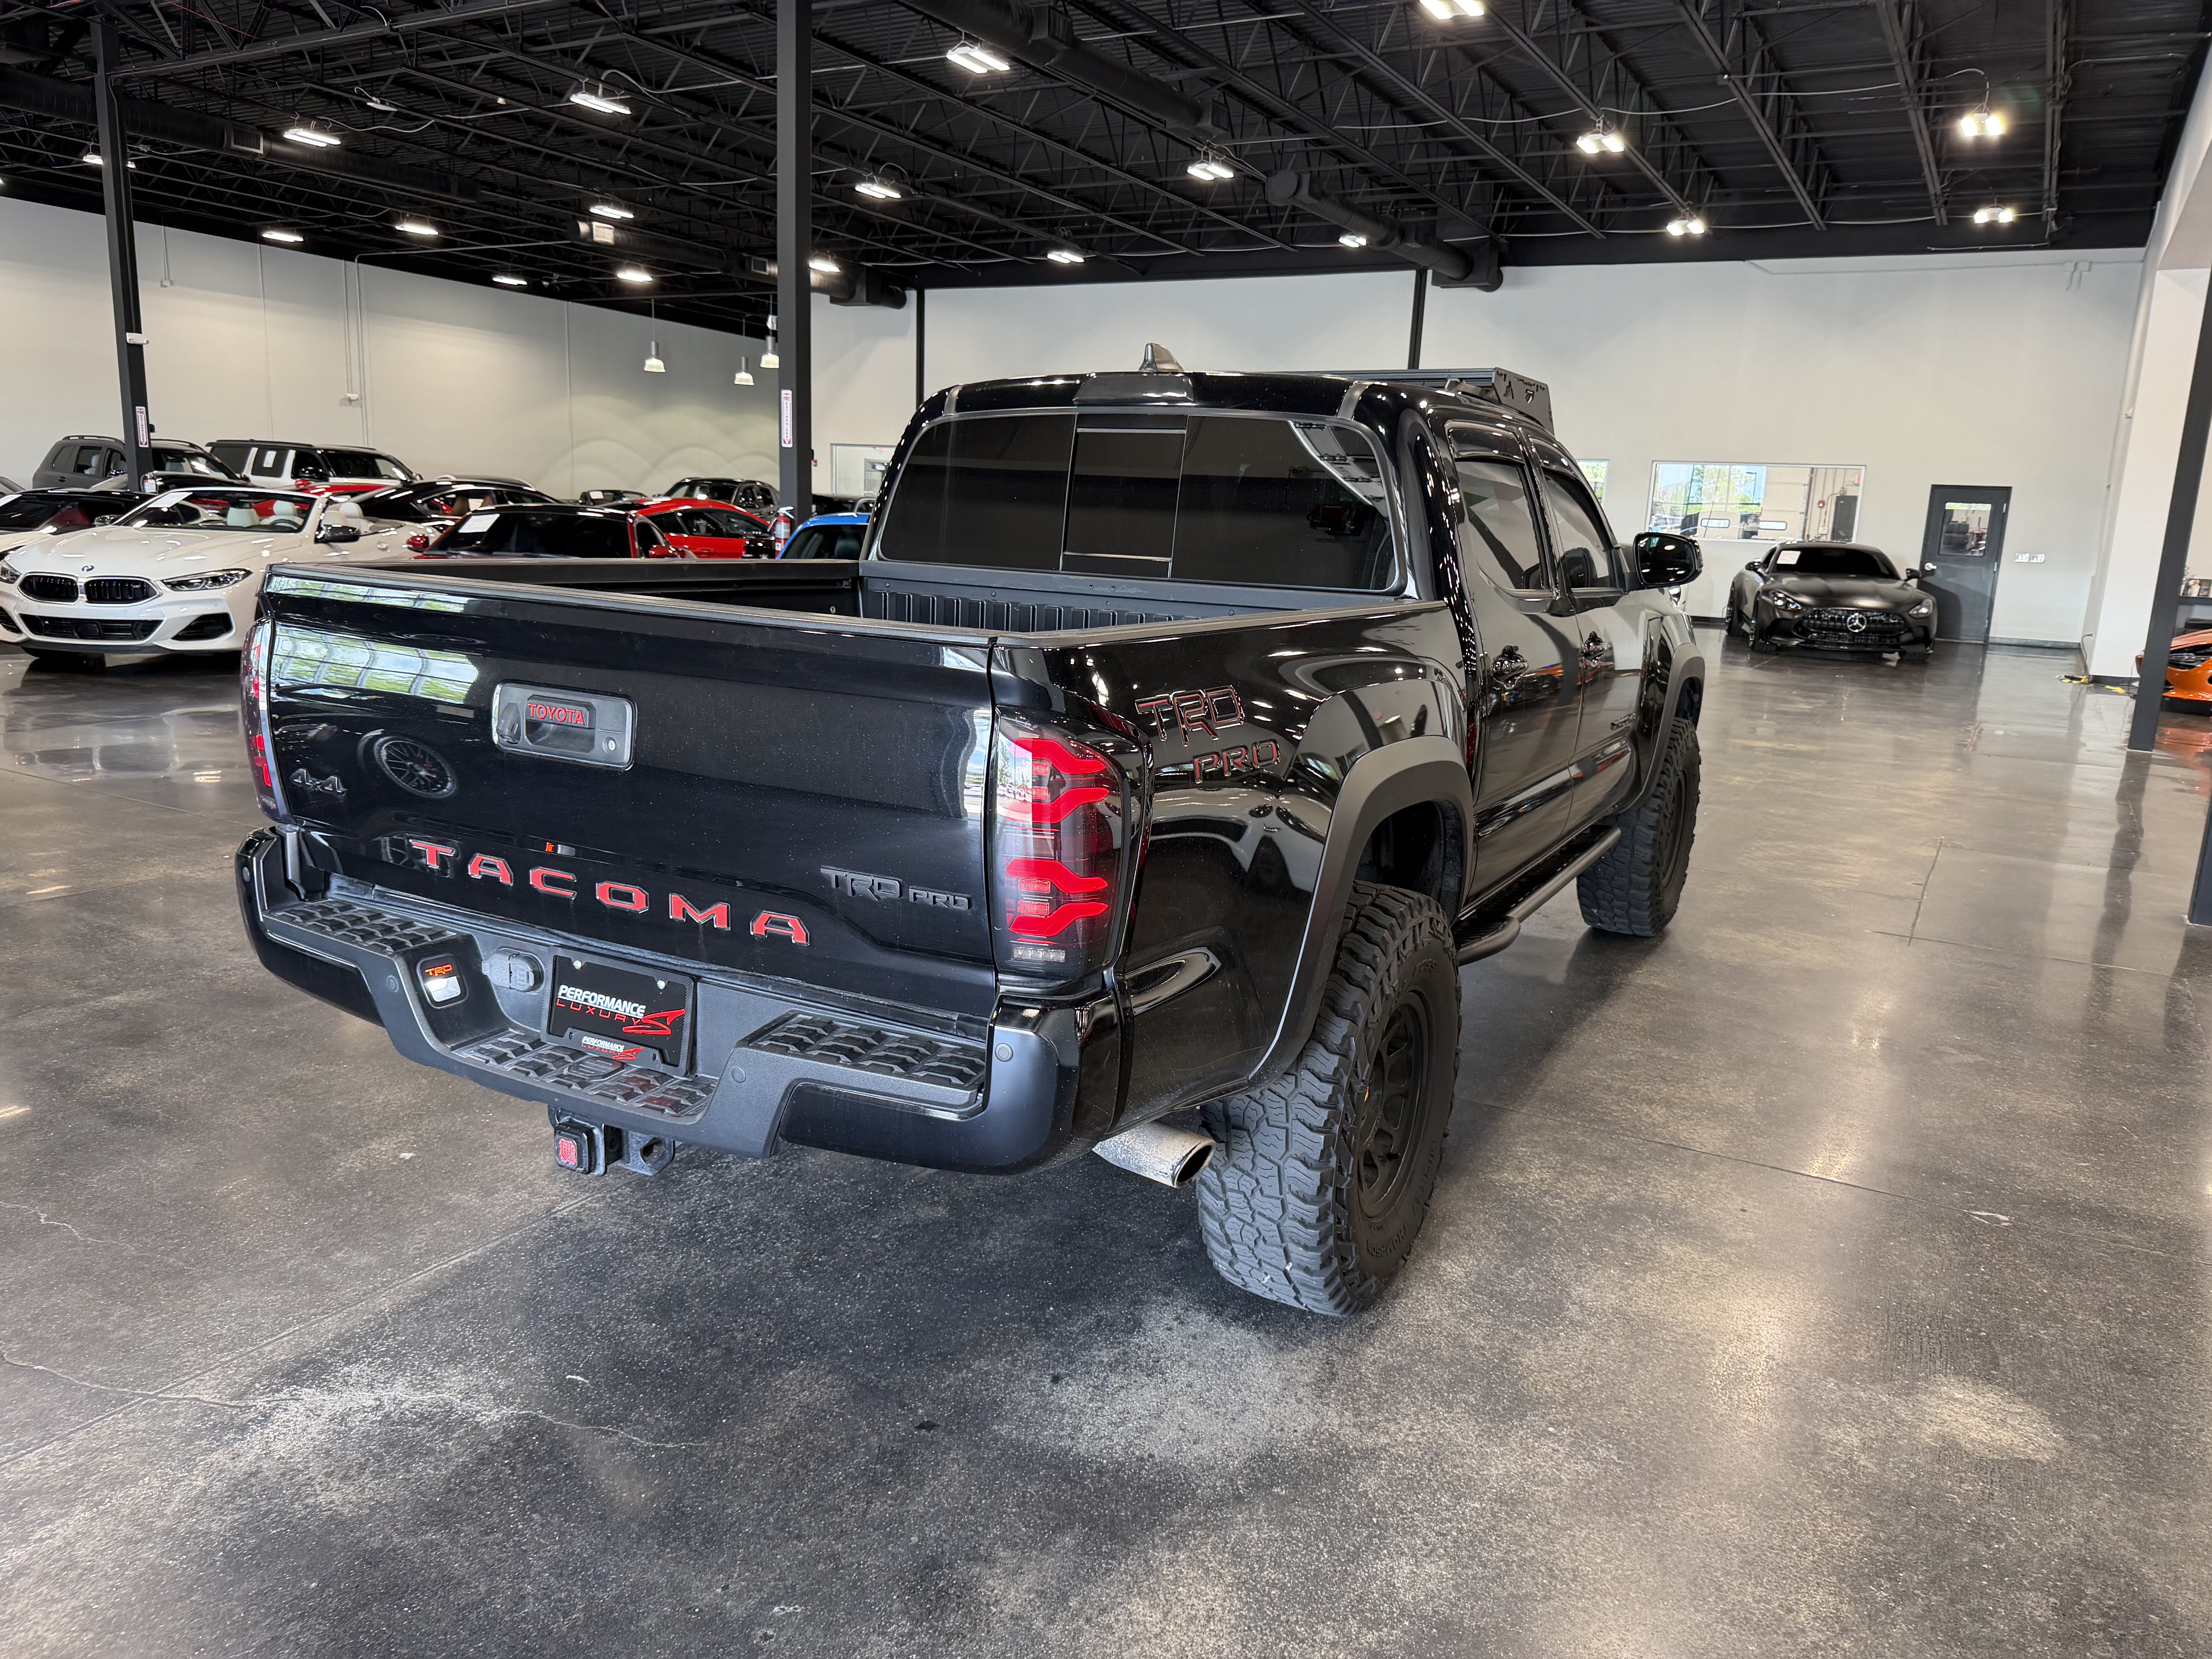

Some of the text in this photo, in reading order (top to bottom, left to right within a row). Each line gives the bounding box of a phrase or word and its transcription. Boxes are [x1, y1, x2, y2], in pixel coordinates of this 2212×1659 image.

[527, 703, 585, 725] TOYOTA
[1135, 685, 1245, 747] TRD
[1193, 739, 1280, 784] PRO
[409, 839, 810, 946] TACOMA
[820, 866, 972, 911] TRD PRO
[425, 964, 453, 976] TRD
[556, 999, 642, 1025] LUXURY
[557, 984, 646, 1018] PERFORMANCE
[582, 1036, 625, 1052] PERFORMANCE
